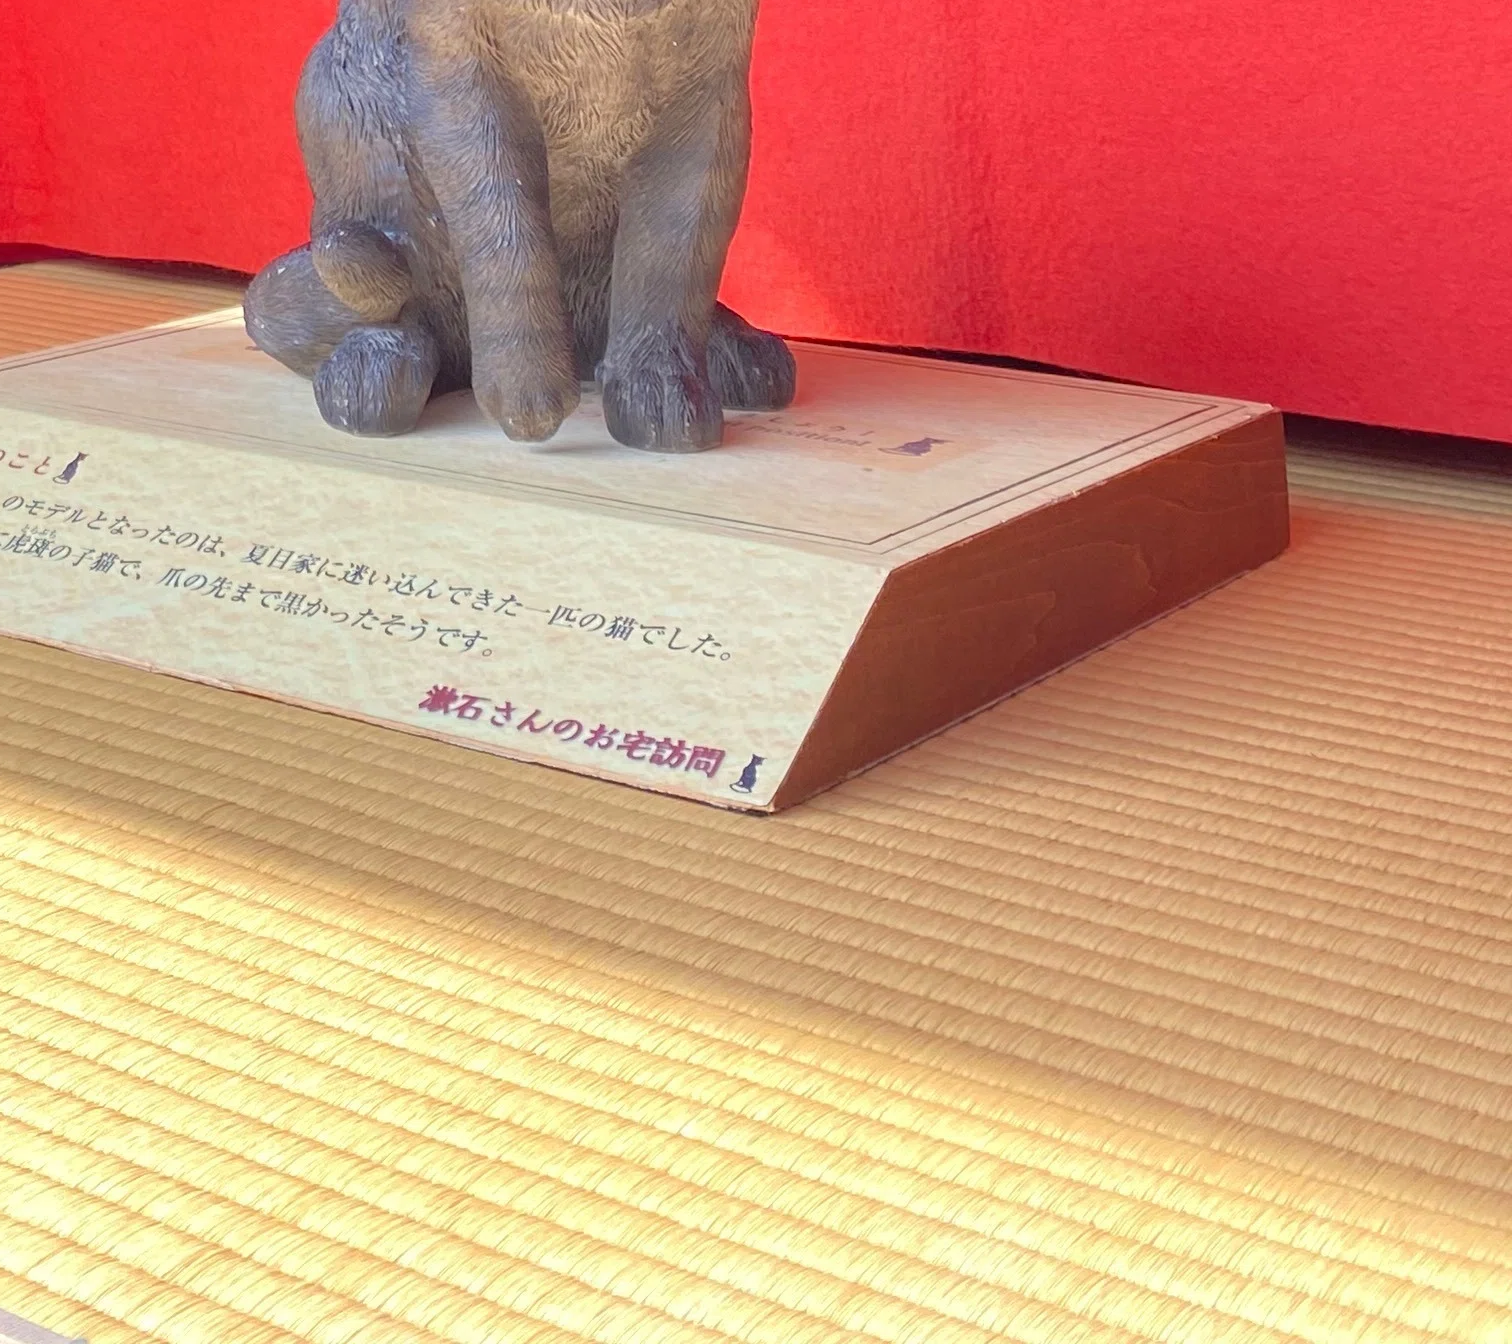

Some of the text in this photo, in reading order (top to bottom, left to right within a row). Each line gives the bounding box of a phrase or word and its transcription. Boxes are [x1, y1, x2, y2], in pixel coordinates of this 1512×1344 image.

[418, 684, 728, 779] 漱石さんのお宅訪問
